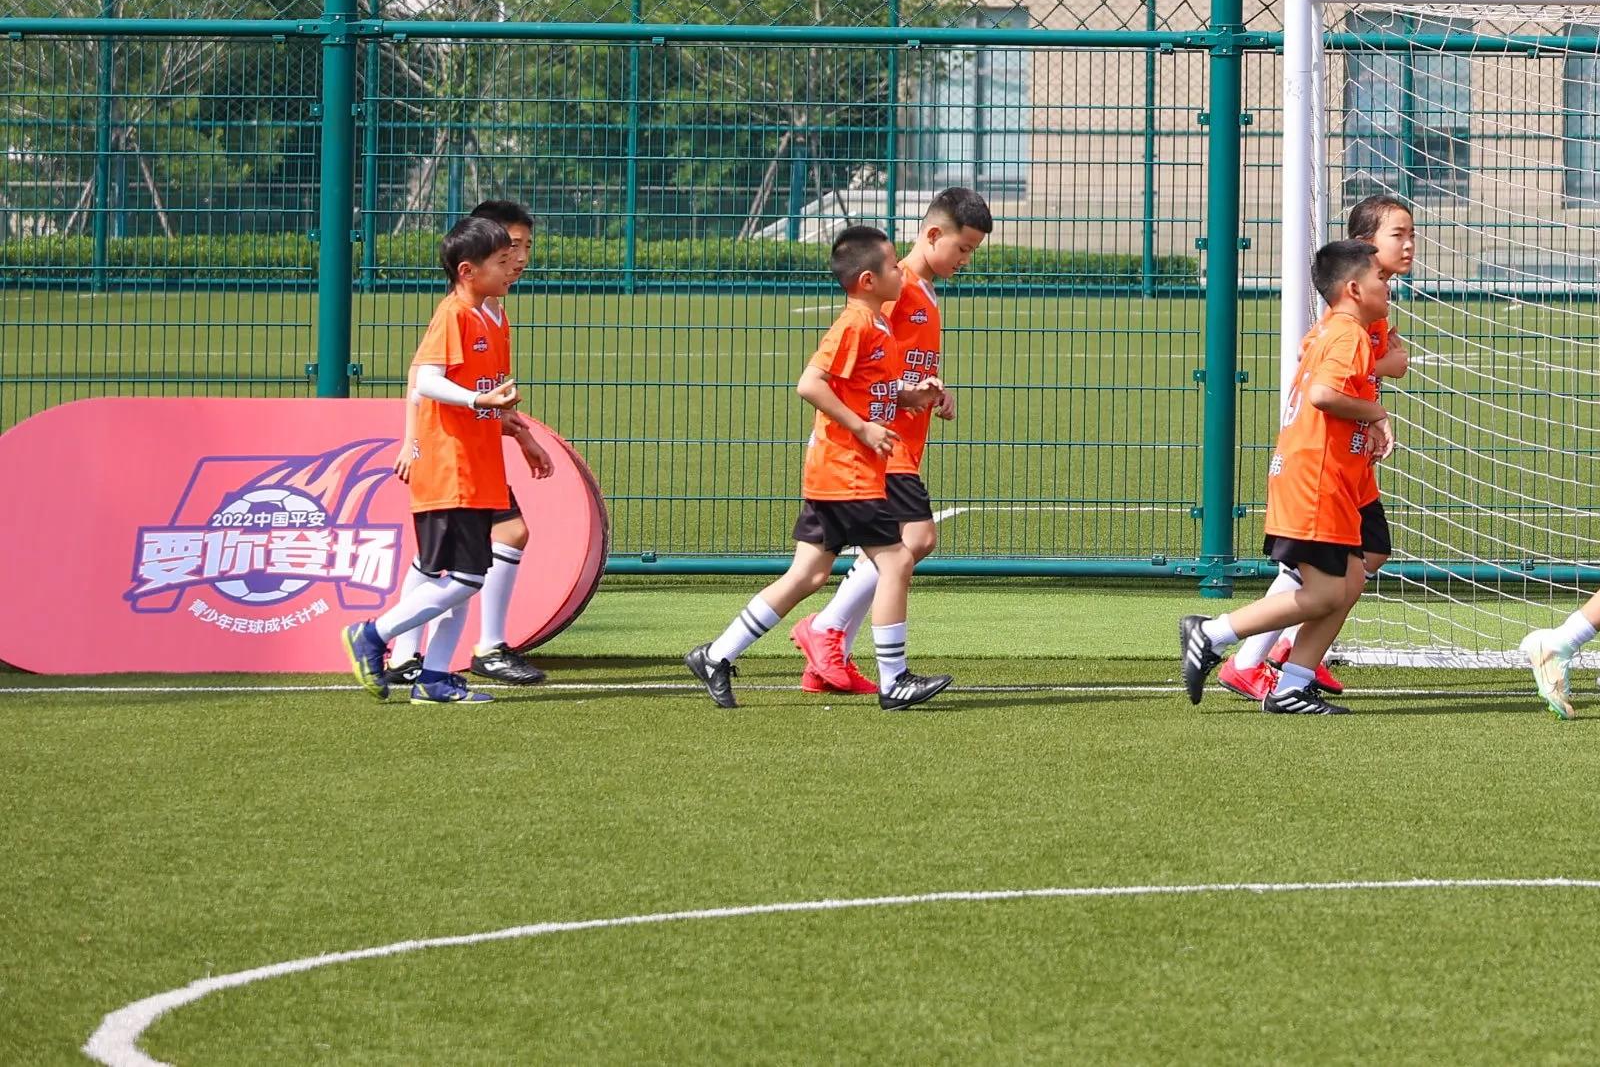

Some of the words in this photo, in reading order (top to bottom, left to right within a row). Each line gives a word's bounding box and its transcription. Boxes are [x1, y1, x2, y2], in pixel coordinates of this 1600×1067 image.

[212, 511, 326, 528] 2022中国平安
[134, 528, 398, 594] 要你登场
[187, 598, 330, 634] 青少年足球成长计划
